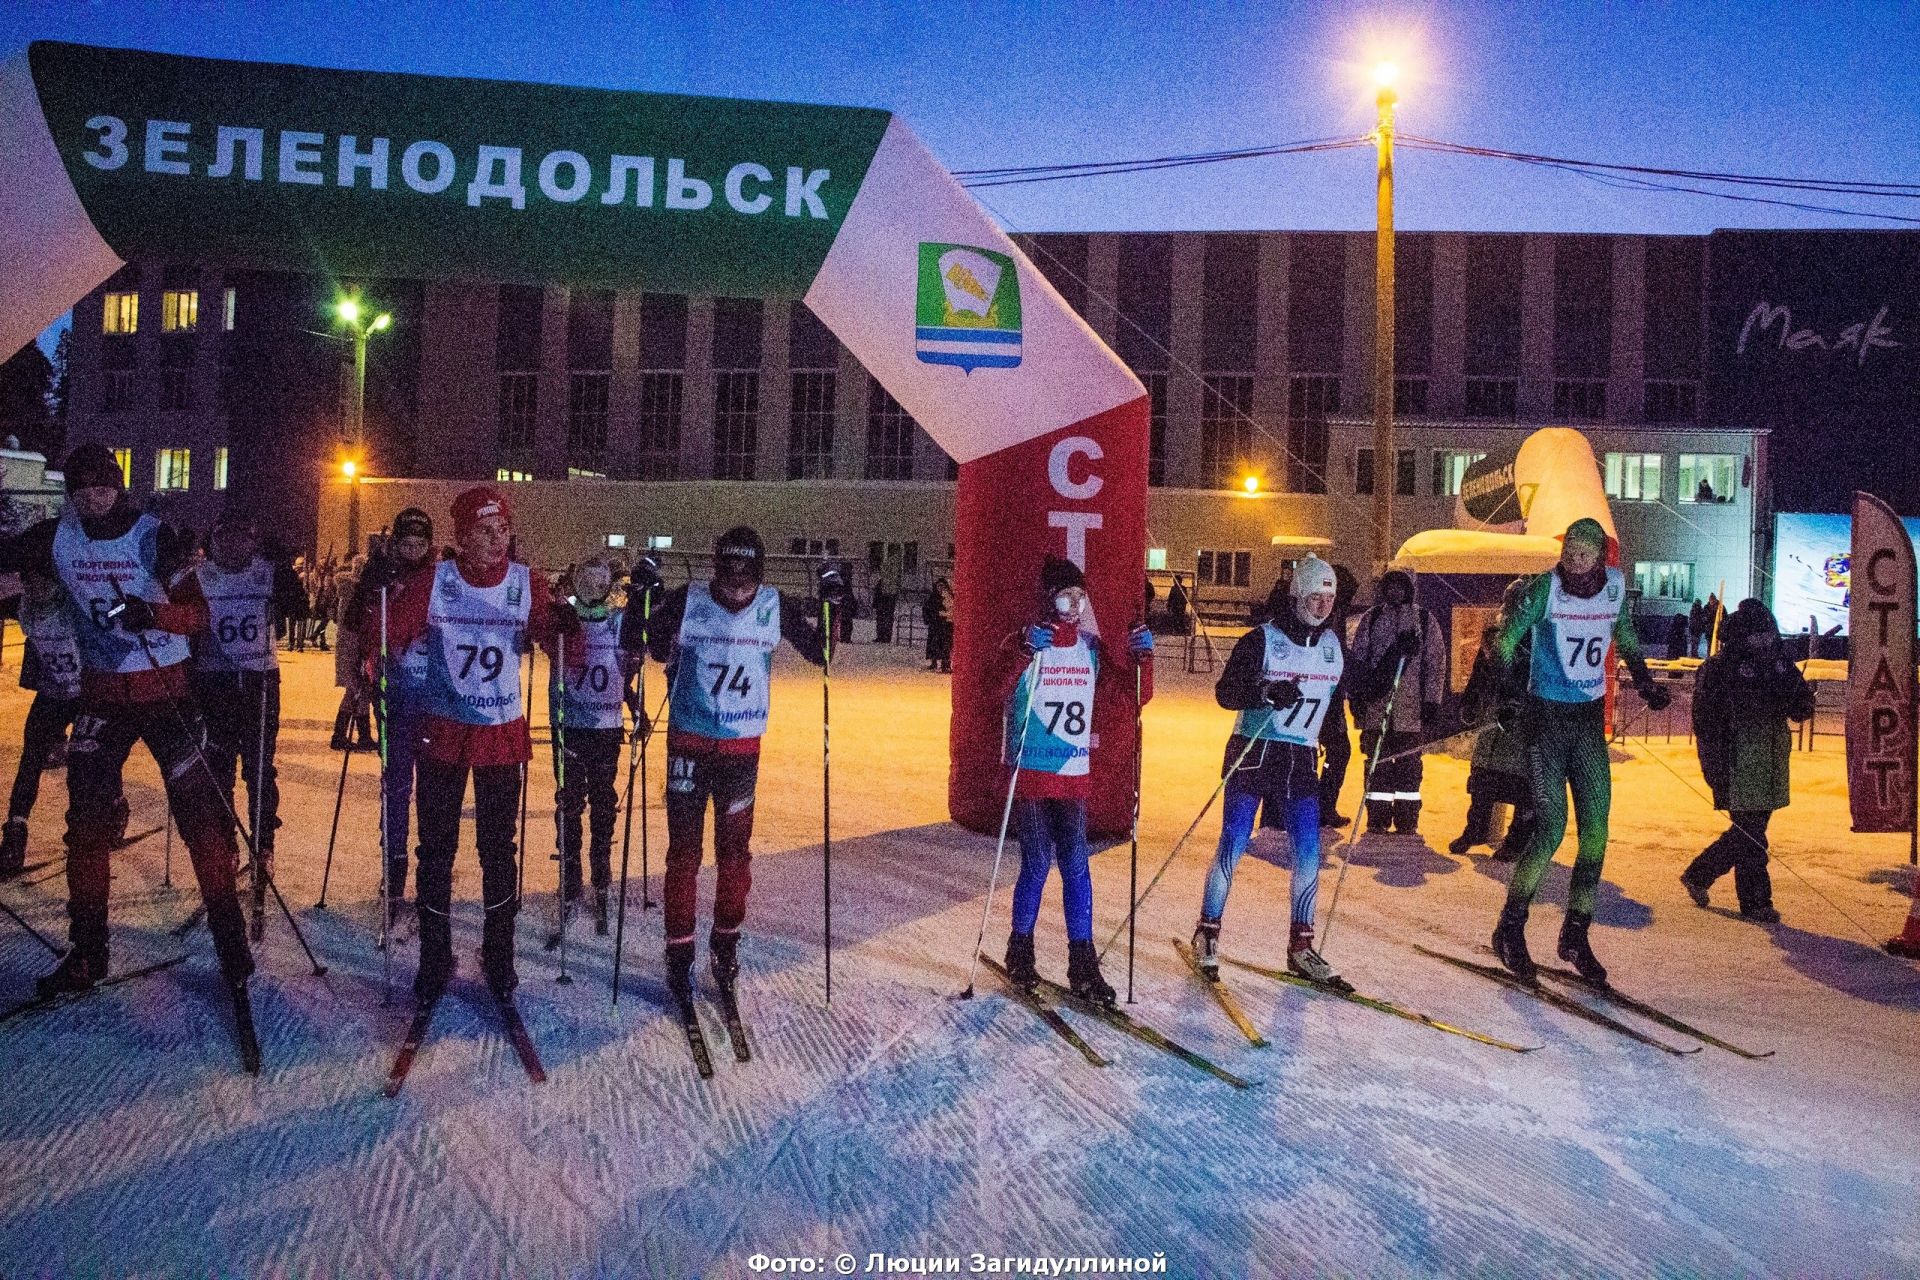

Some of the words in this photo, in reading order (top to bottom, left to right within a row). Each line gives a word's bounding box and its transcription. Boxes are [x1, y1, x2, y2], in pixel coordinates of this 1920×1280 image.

[83, 115, 831, 220] ЗЕЛЕНОДОЛЬСК
[1736, 302, 1901, 366] Маяк
[219, 615, 258, 643] 66
[456, 644, 504, 683] 79
[1566, 636, 1603, 668] 76
[574, 665, 609, 692] 70
[708, 663, 751, 699] 74
[1040, 666, 1090, 675] СПОРТИВНАЯ
[1043, 678, 1073, 687] ШКОЛА
[1863, 548, 1901, 808] СТАРТ
[1044, 701, 1086, 735] 78
[1283, 697, 1321, 729] 77
